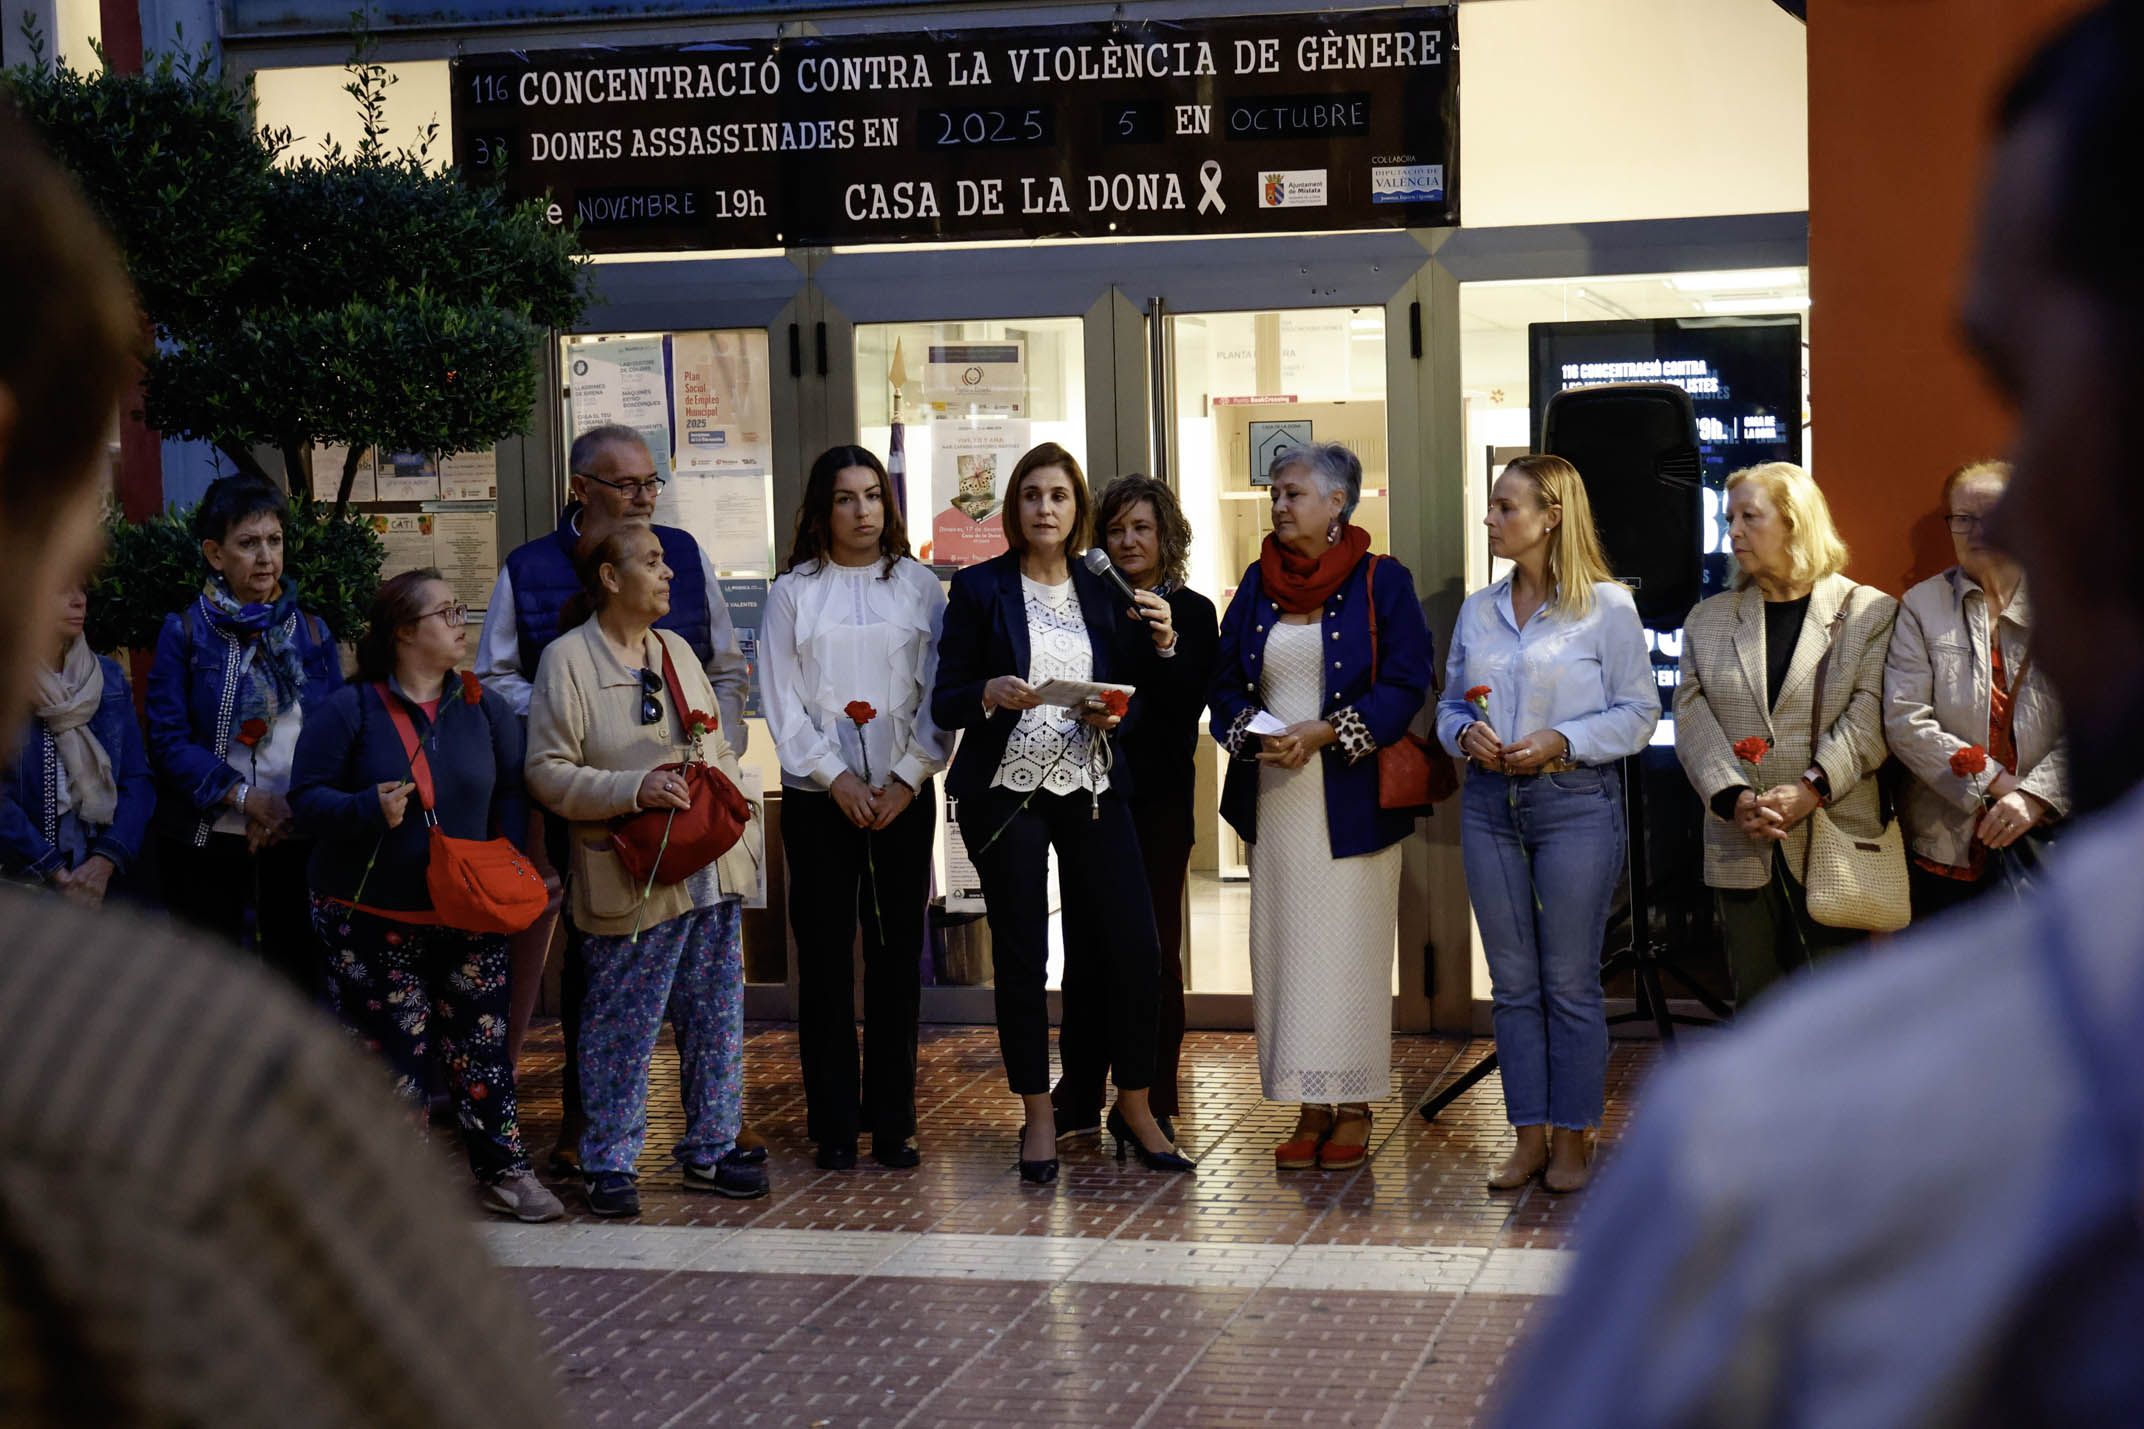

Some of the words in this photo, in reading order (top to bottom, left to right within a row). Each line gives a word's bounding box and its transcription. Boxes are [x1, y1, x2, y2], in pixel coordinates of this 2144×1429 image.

[472, 74, 509, 103] 116
[519, 56, 780, 105] CONCENTRACIÓ
[798, 54, 932, 92] CONTRA
[948, 52, 992, 86] LA
[1008, 40, 1216, 82] VIOLÈNCIA
[1235, 39, 1280, 75] DE
[1298, 30, 1441, 71] GÈNERE
[531, 129, 622, 161] DONES
[630, 120, 855, 157] ASSASSINADES
[863, 118, 899, 147] EN
[937, 110, 1042, 144] 2025
[1119, 110, 1137, 135] 5
[1175, 105, 1211, 135] EN
[1231, 102, 1364, 131] OCTUBRE
[845, 181, 941, 221] CASA
[956, 179, 1003, 216] DE
[1021, 177, 1070, 214] LA
[1088, 173, 1186, 212] DONA
[578, 193, 695, 223] NOVEMBRE
[715, 189, 767, 218] 19h
[1216, 350, 1252, 359] PLANTA
[684, 371, 701, 381] Plan
[1580, 359, 1662, 379] CONCENTRACIÓ
[1663, 360, 1707, 377] CONTRA
[685, 383, 706, 393] Social
[685, 395, 694, 405] de
[694, 394, 720, 409] Empleo
[686, 406, 718, 418] Municipal
[686, 418, 708, 428] 2025
